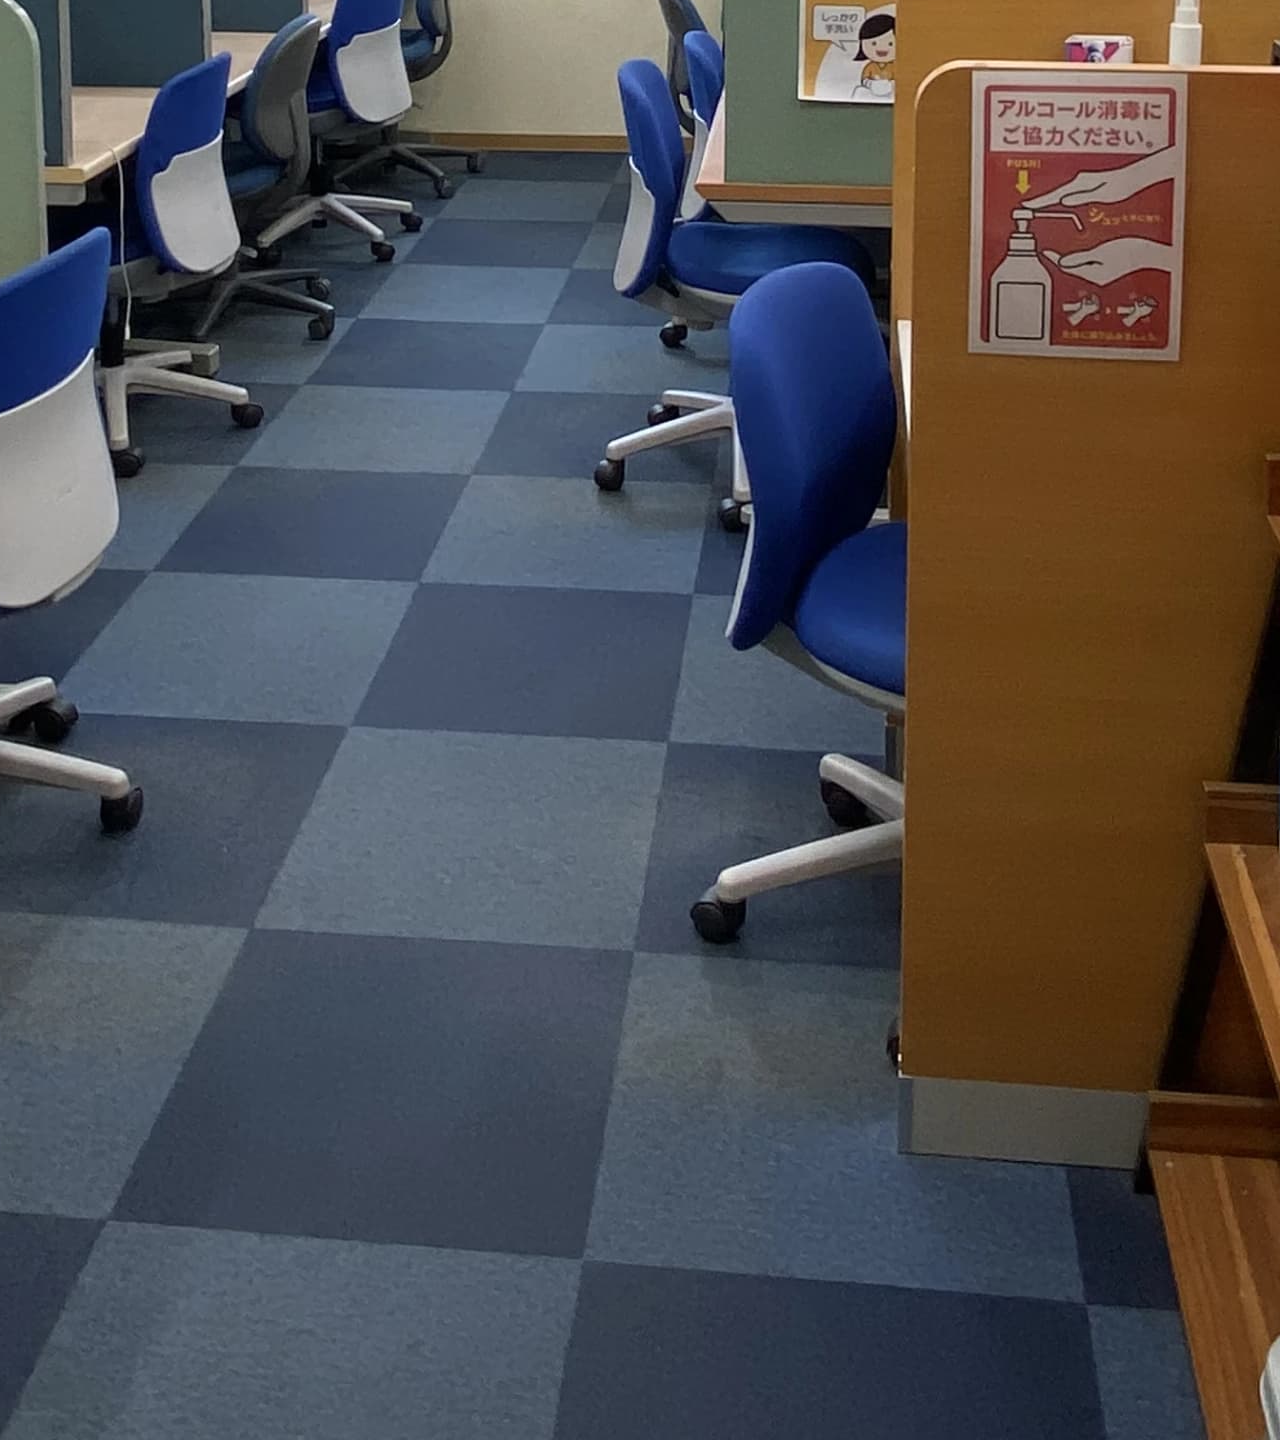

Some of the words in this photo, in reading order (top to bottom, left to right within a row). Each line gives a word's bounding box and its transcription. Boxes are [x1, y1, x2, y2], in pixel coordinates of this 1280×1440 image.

[997, 99, 1162, 121] アルコール消毒に
[1002, 126, 1154, 148] ご協力ください。
